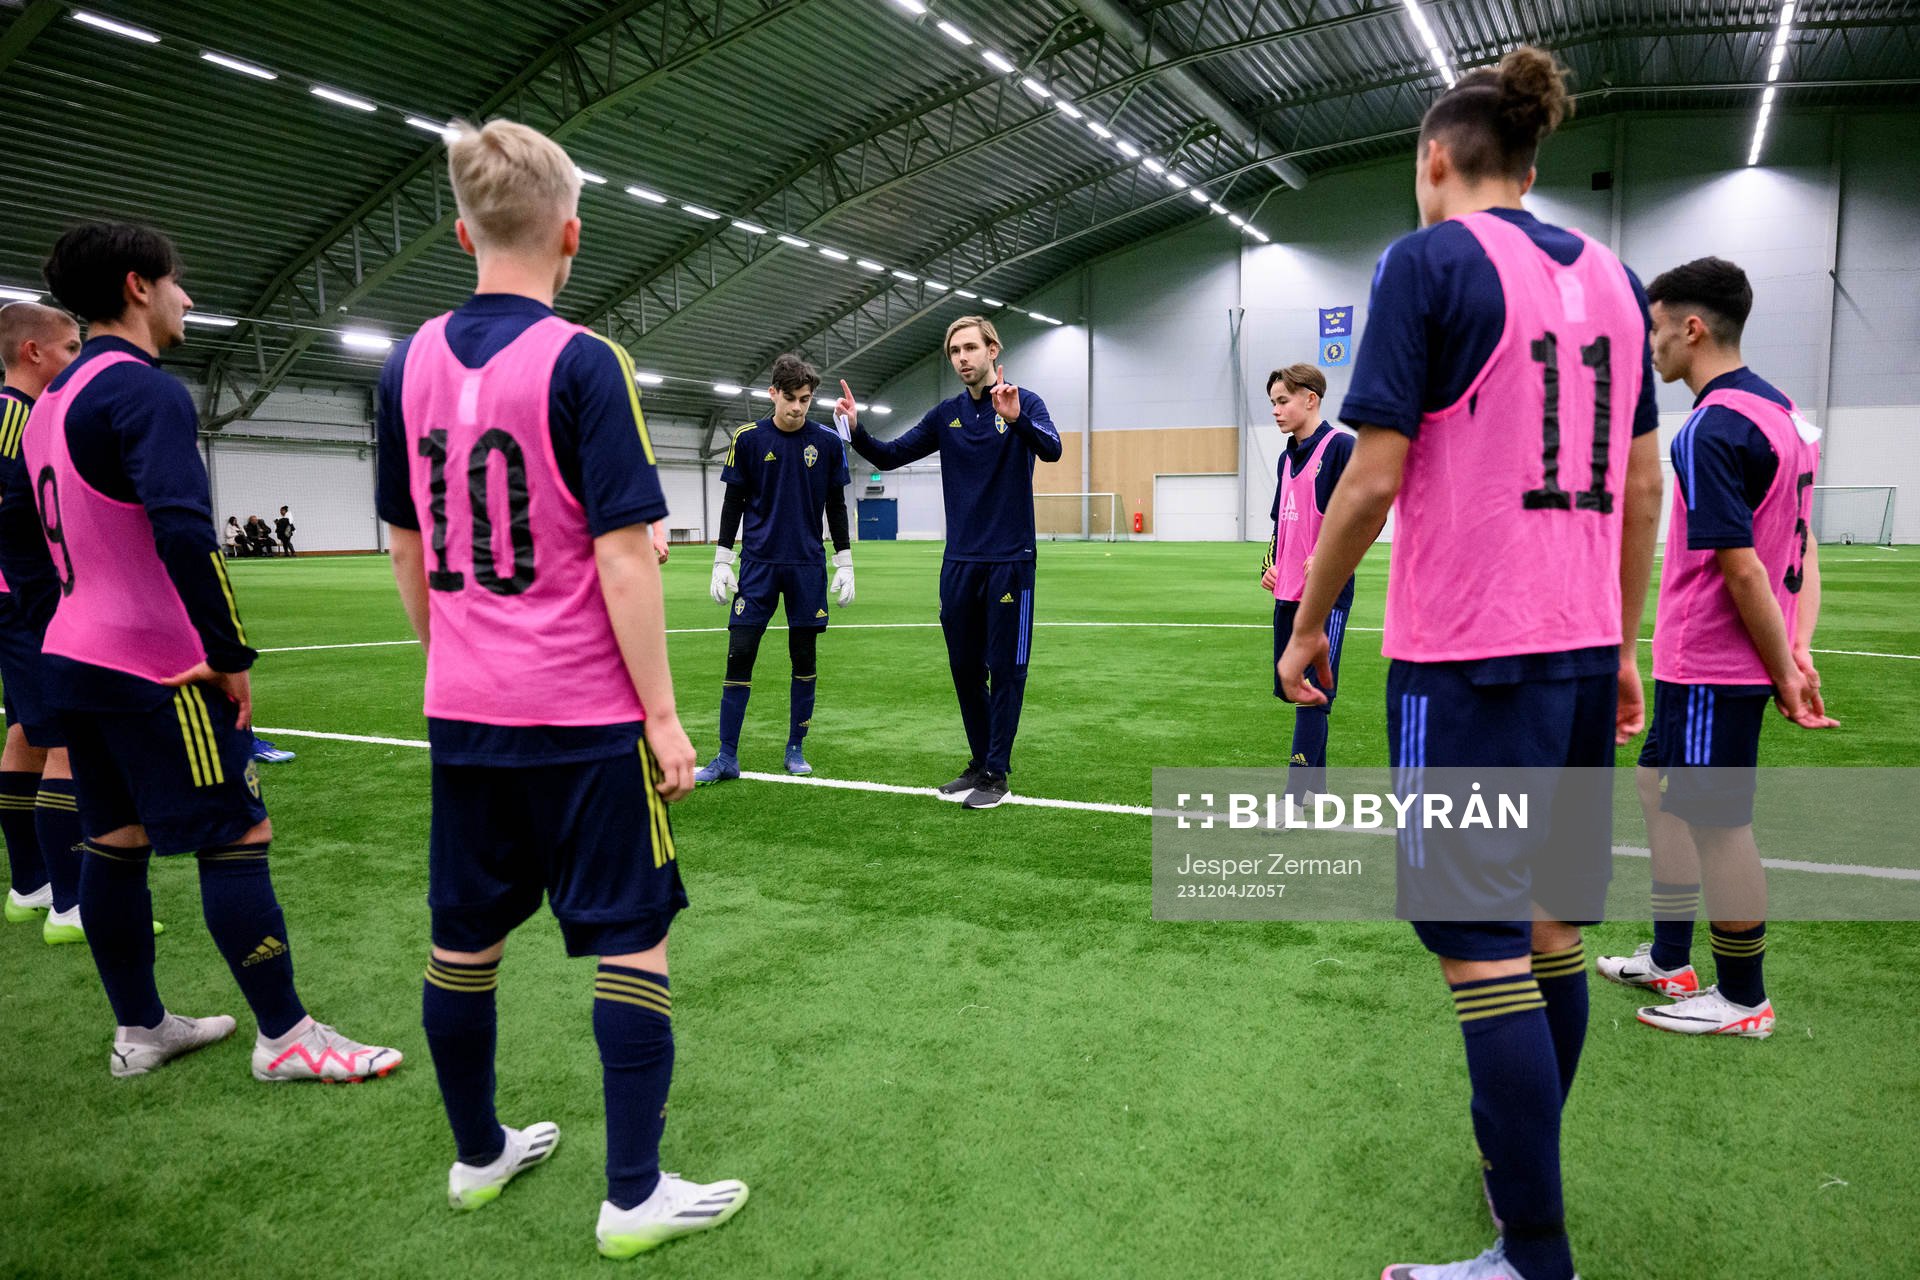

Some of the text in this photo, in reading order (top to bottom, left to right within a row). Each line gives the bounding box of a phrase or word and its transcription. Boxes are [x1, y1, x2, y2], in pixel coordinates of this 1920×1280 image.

[1522, 331, 1614, 514] 11
[37, 465, 75, 597] 9
[418, 428, 536, 597] 10
